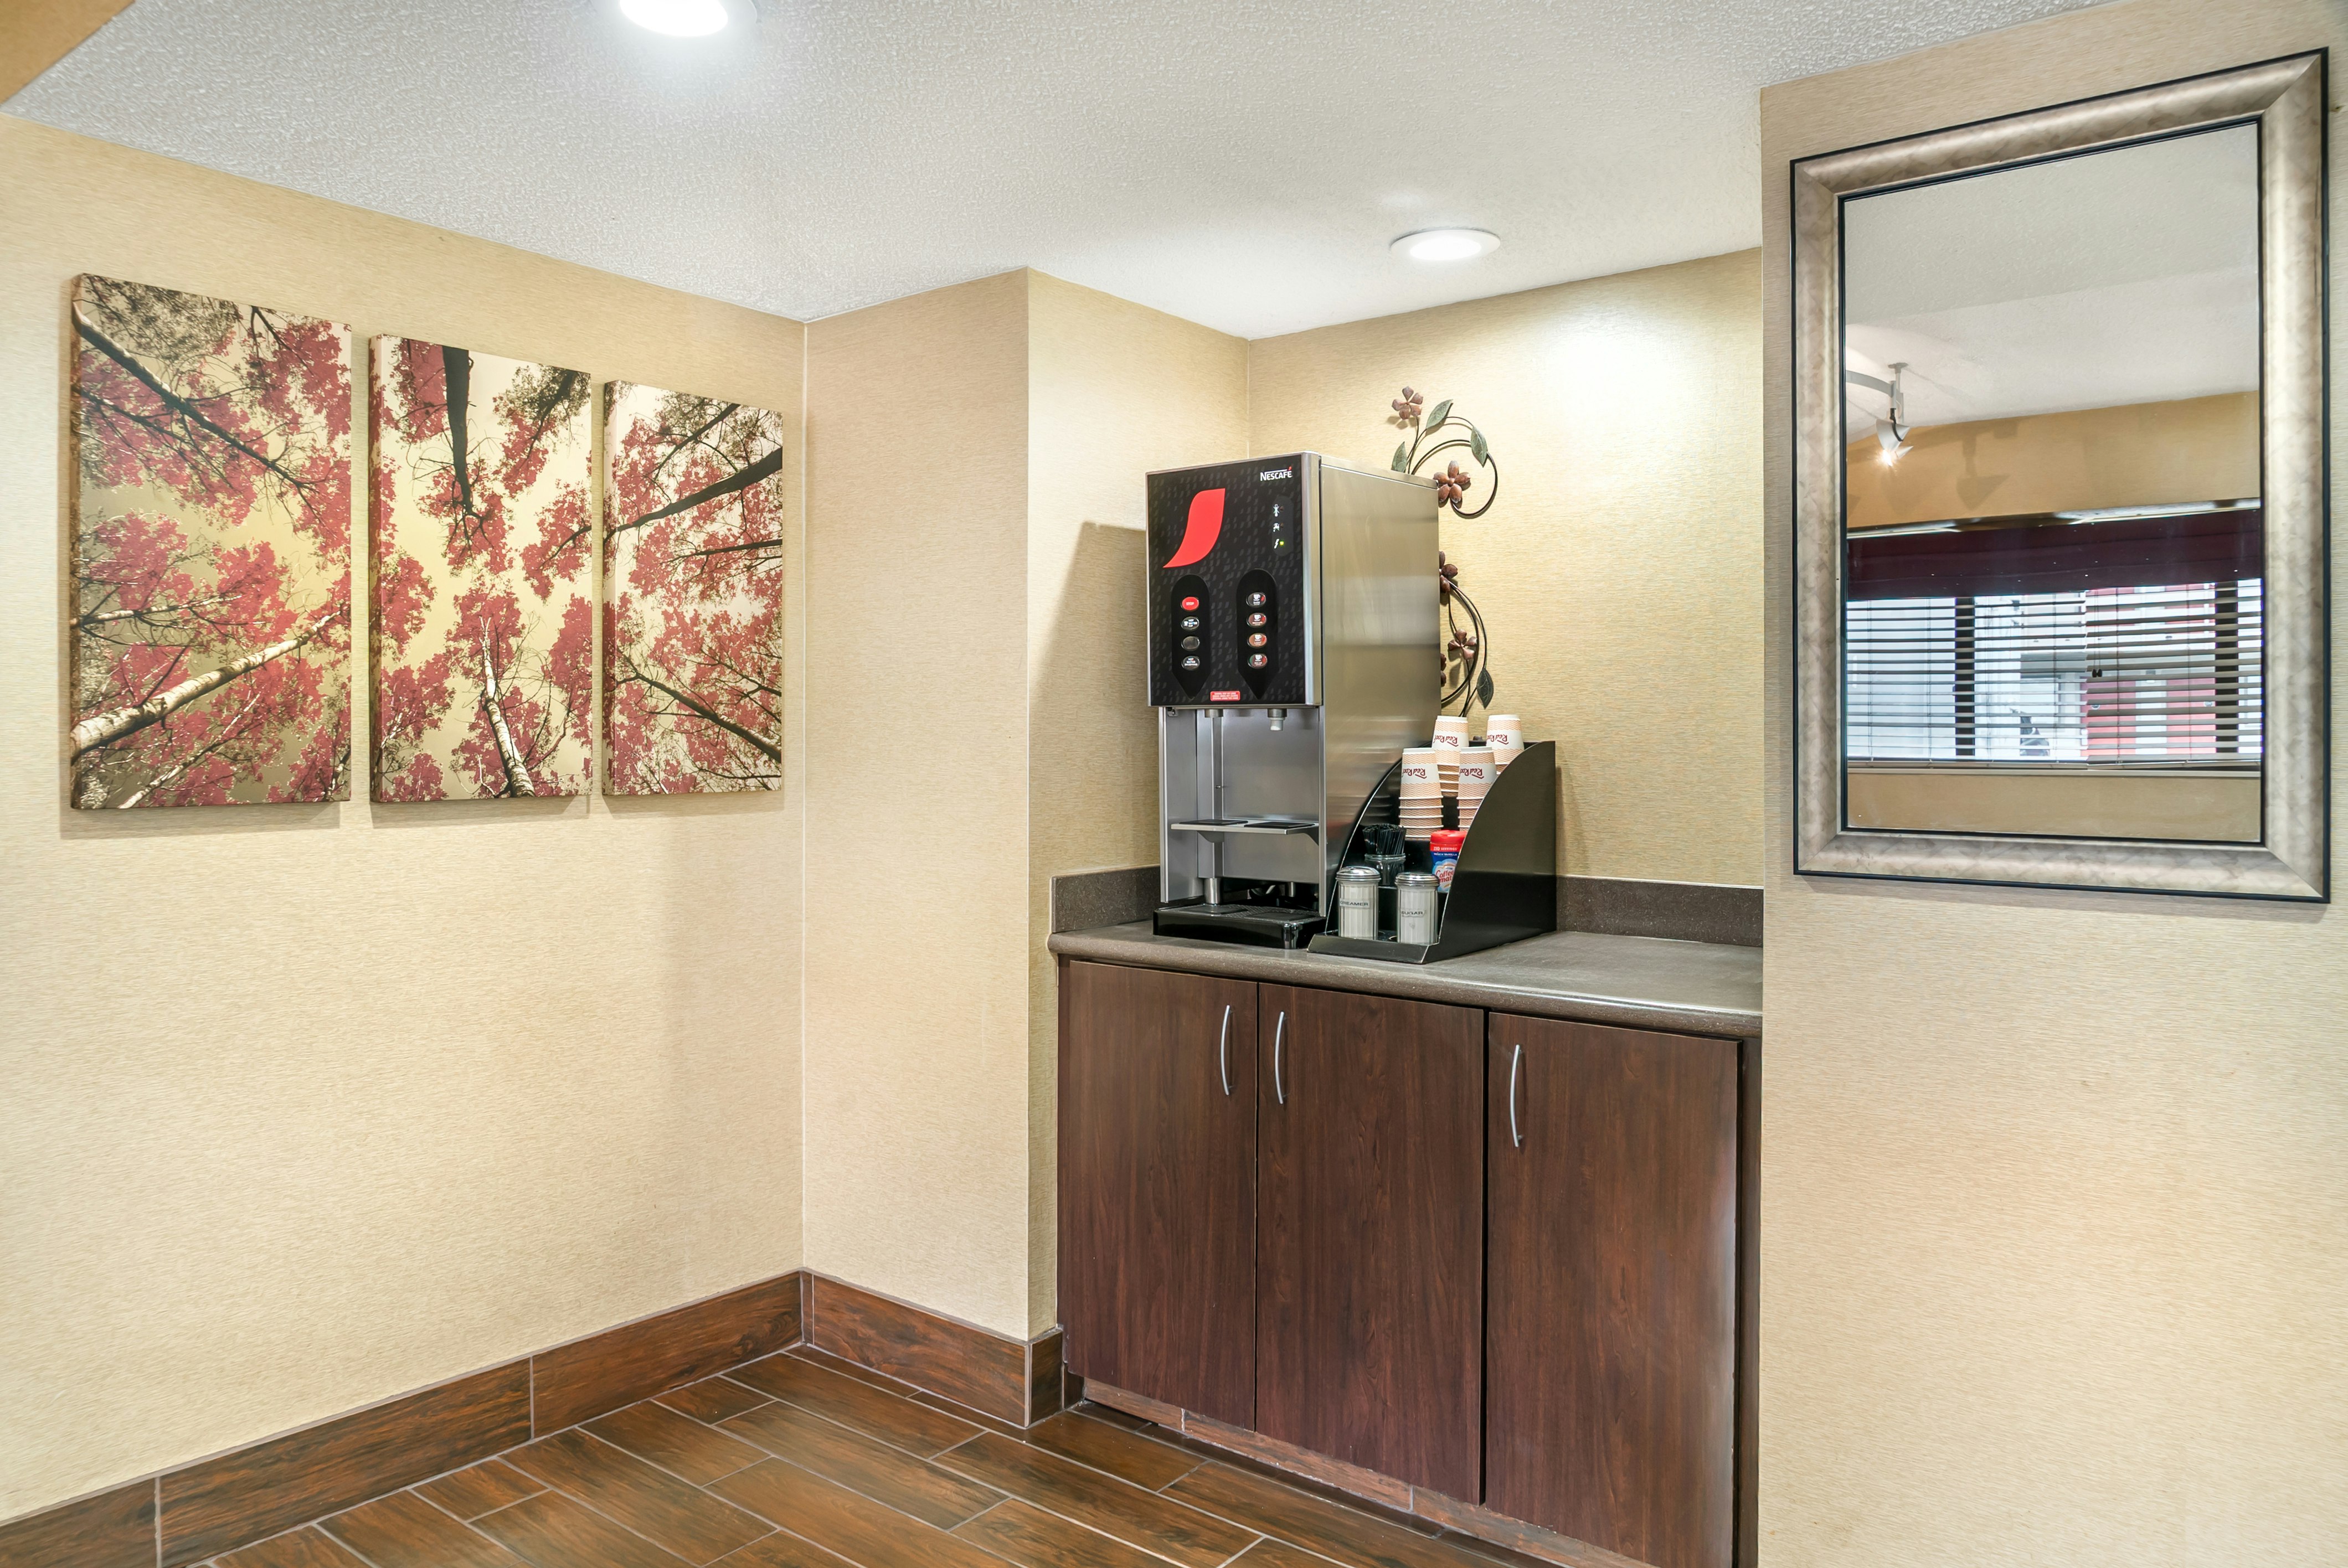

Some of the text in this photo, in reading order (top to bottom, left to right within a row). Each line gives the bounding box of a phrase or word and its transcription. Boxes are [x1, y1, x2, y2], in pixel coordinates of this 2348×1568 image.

[1260, 466, 1293, 481] NESCAFÉ
[1445, 735, 1458, 745] Red
[1495, 734, 1508, 743] Red
[1413, 768, 1426, 777] Red
[1470, 768, 1483, 777] Red
